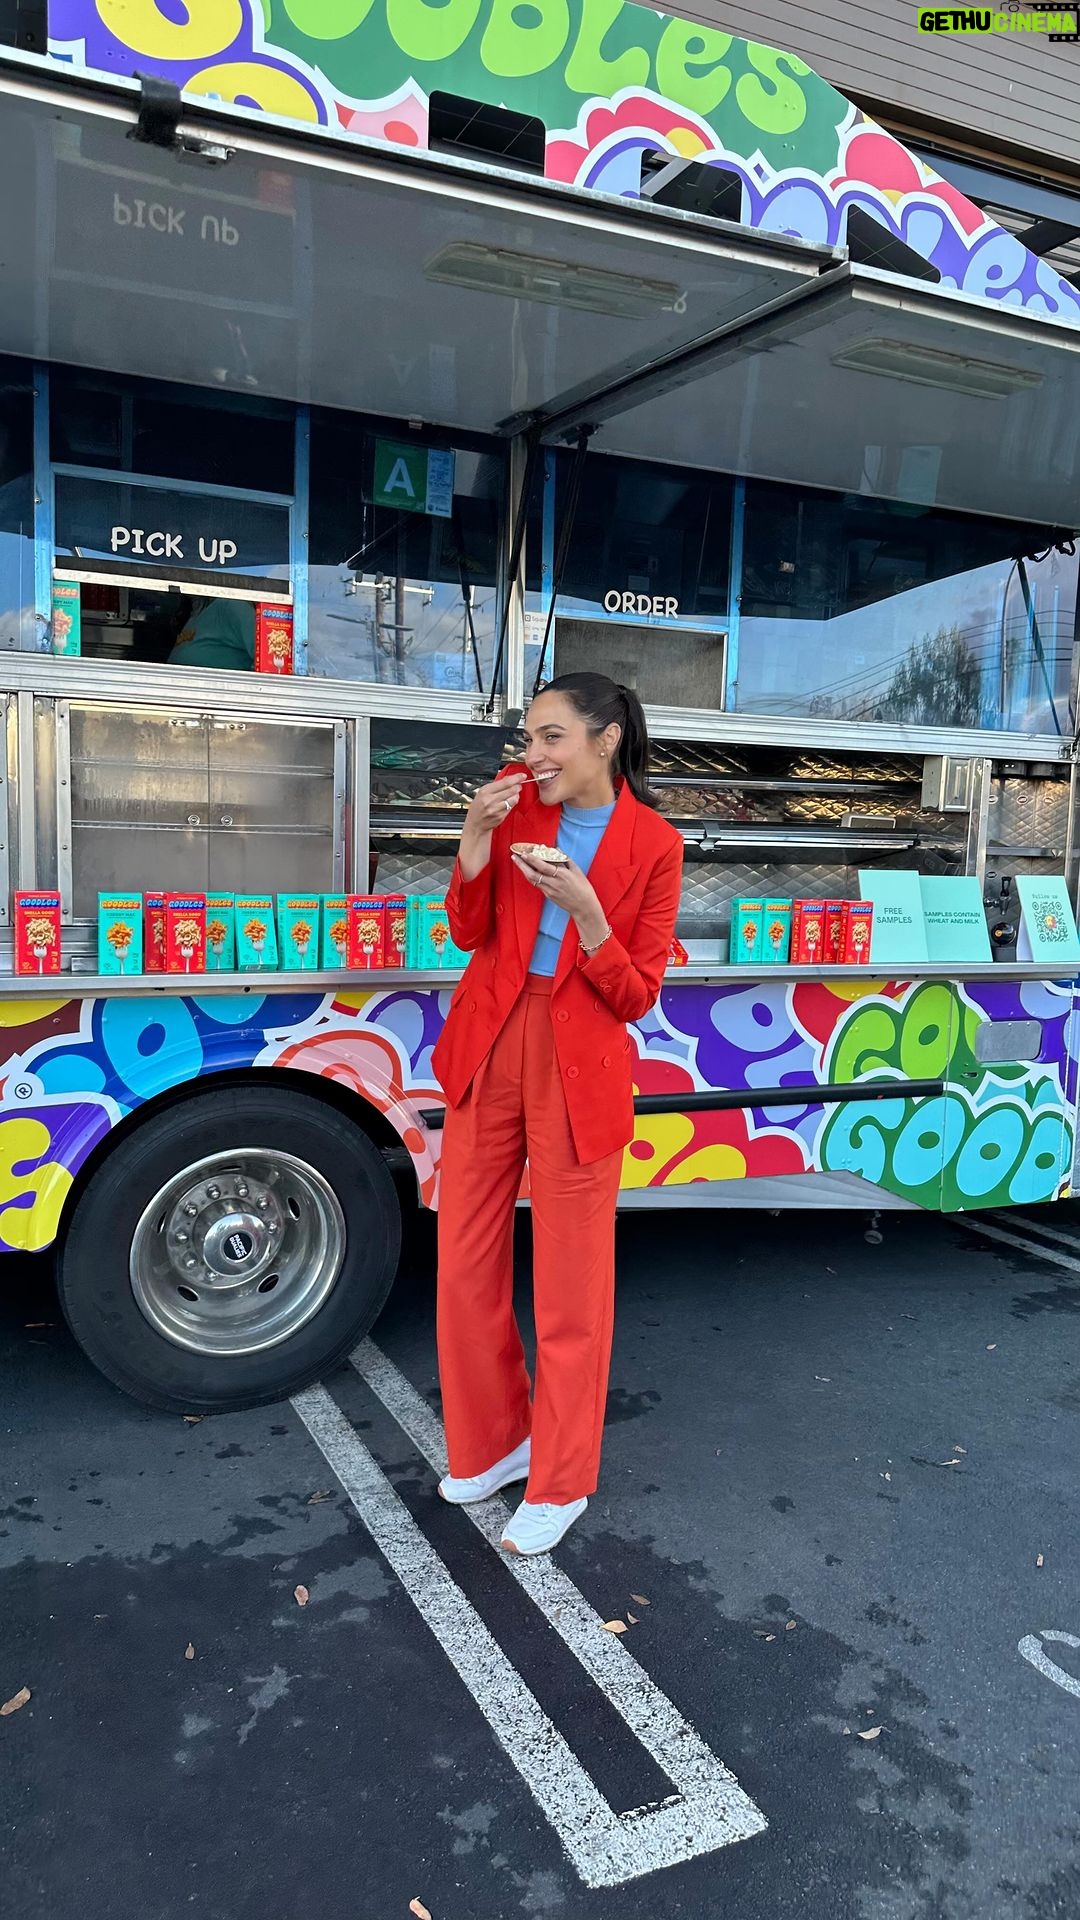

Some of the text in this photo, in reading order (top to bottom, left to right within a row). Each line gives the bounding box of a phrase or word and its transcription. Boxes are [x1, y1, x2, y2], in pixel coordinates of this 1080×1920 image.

[383, 457, 415, 497] A
[110, 526, 237, 564] PICK UP
[604, 589, 679, 619] ORDER
[876, 916, 912, 924] SAMPLES
[884, 907, 902, 915] FREE
[826, 1096, 1071, 1204] GOOD
